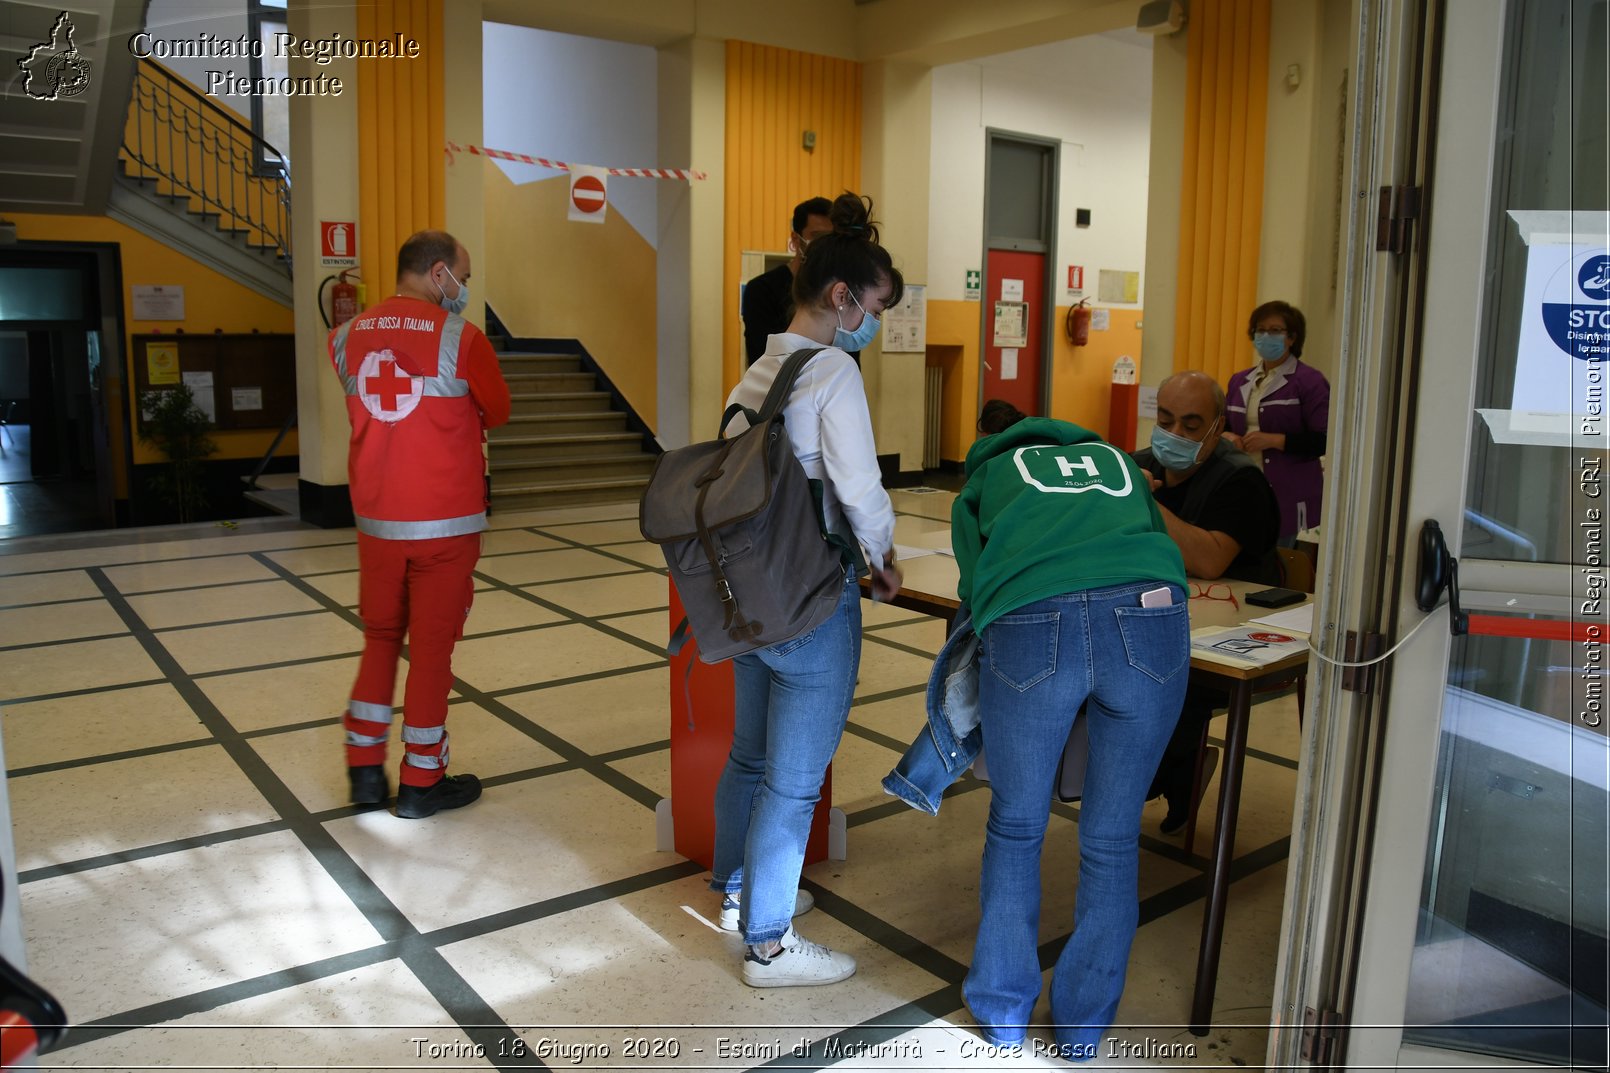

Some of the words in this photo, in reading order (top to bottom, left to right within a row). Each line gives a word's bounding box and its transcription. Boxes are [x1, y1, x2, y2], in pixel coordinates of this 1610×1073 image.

[355, 317, 376, 331] CROCE
[377, 316, 400, 329] ROSSA
[403, 317, 434, 332] ITALIANA
[1054, 456, 1100, 477] H
[1064, 479, 1103, 487] 25.04.2020
